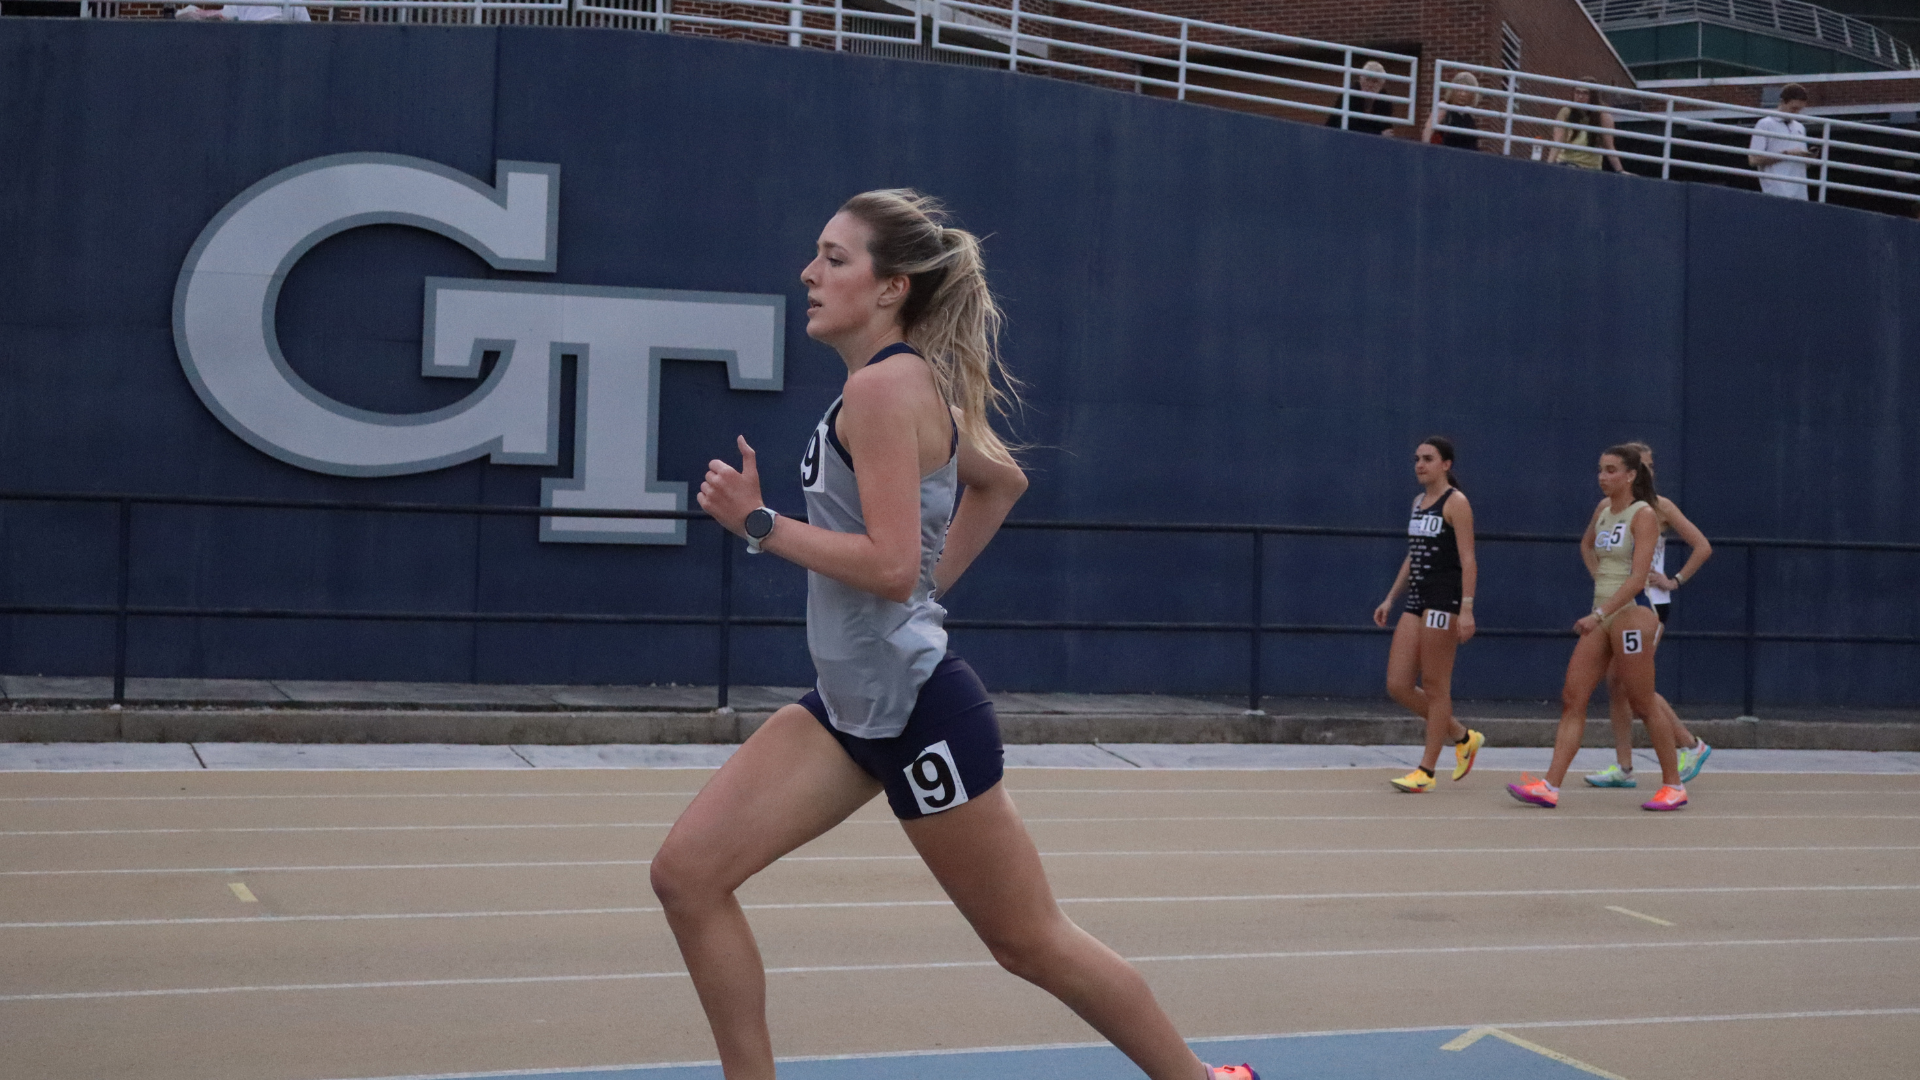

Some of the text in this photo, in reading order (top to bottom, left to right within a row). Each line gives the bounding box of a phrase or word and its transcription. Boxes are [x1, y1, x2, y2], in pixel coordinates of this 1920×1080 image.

[172, 151, 786, 545] GT
[803, 429, 820, 487] 9
[1424, 516, 1439, 532] 10
[1610, 525, 1622, 544] 5
[1430, 611, 1447, 628] 10
[1625, 632, 1638, 651] 5
[911, 752, 956, 808] 9
